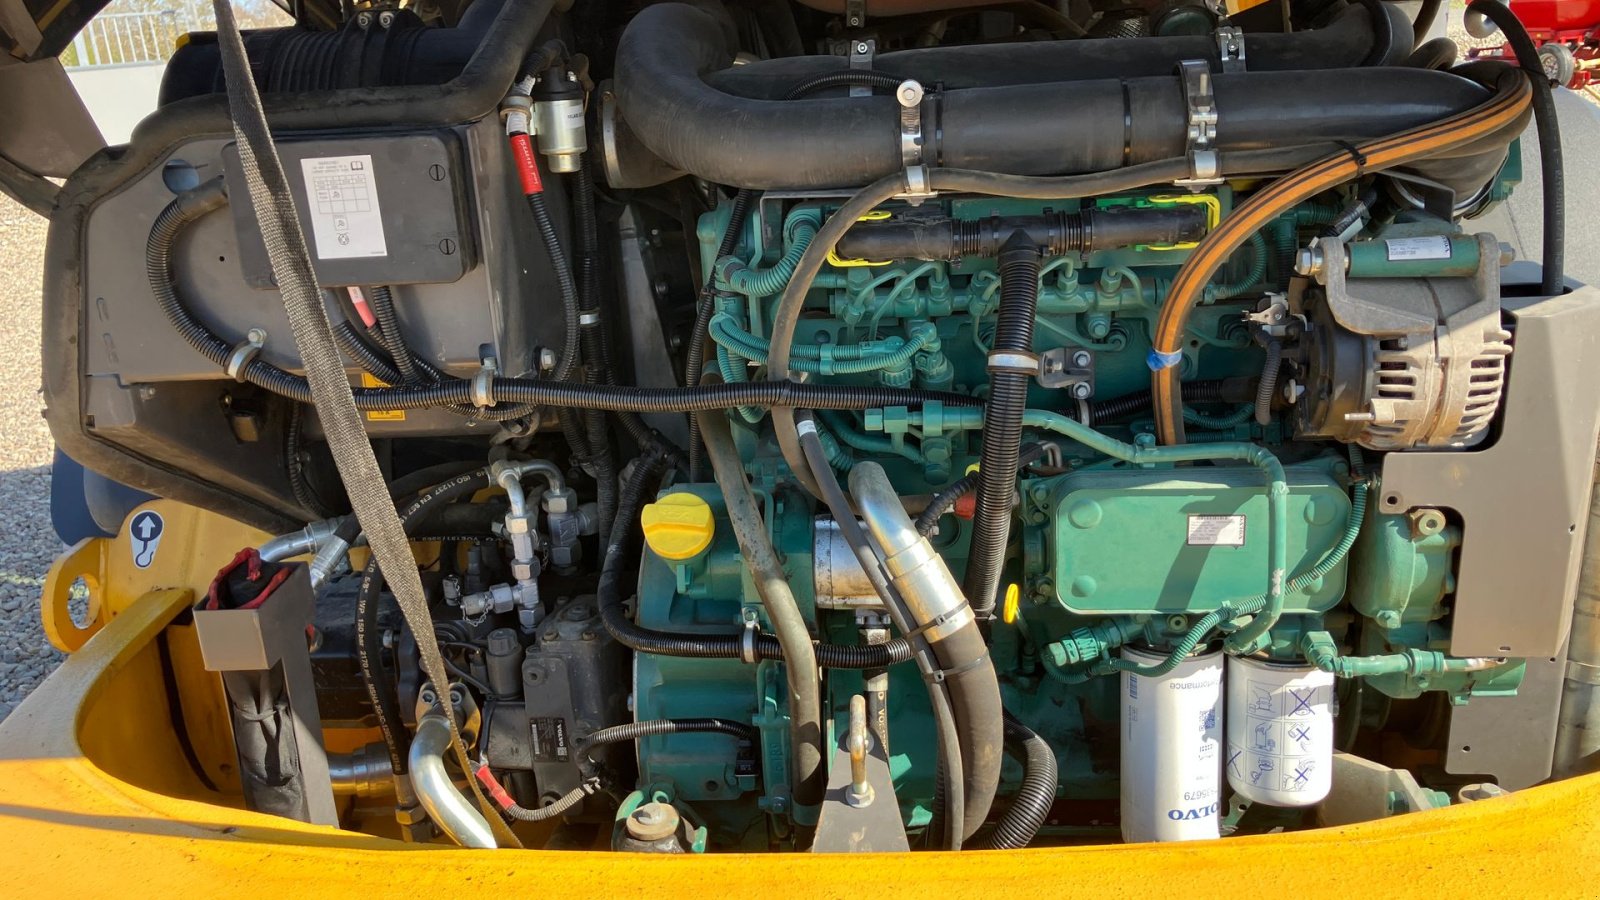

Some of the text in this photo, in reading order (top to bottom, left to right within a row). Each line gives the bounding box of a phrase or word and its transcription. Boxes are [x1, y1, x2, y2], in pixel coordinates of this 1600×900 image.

[456, 475, 471, 484] ISO
[435, 480, 456, 495] 11237
[420, 494, 432, 505] EN
[408, 502, 421, 516] 857
[359, 600, 366, 614] WP
[360, 650, 369, 670] 2170
[368, 683, 379, 703] MSHA
[1168, 801, 1221, 821] OLVO
